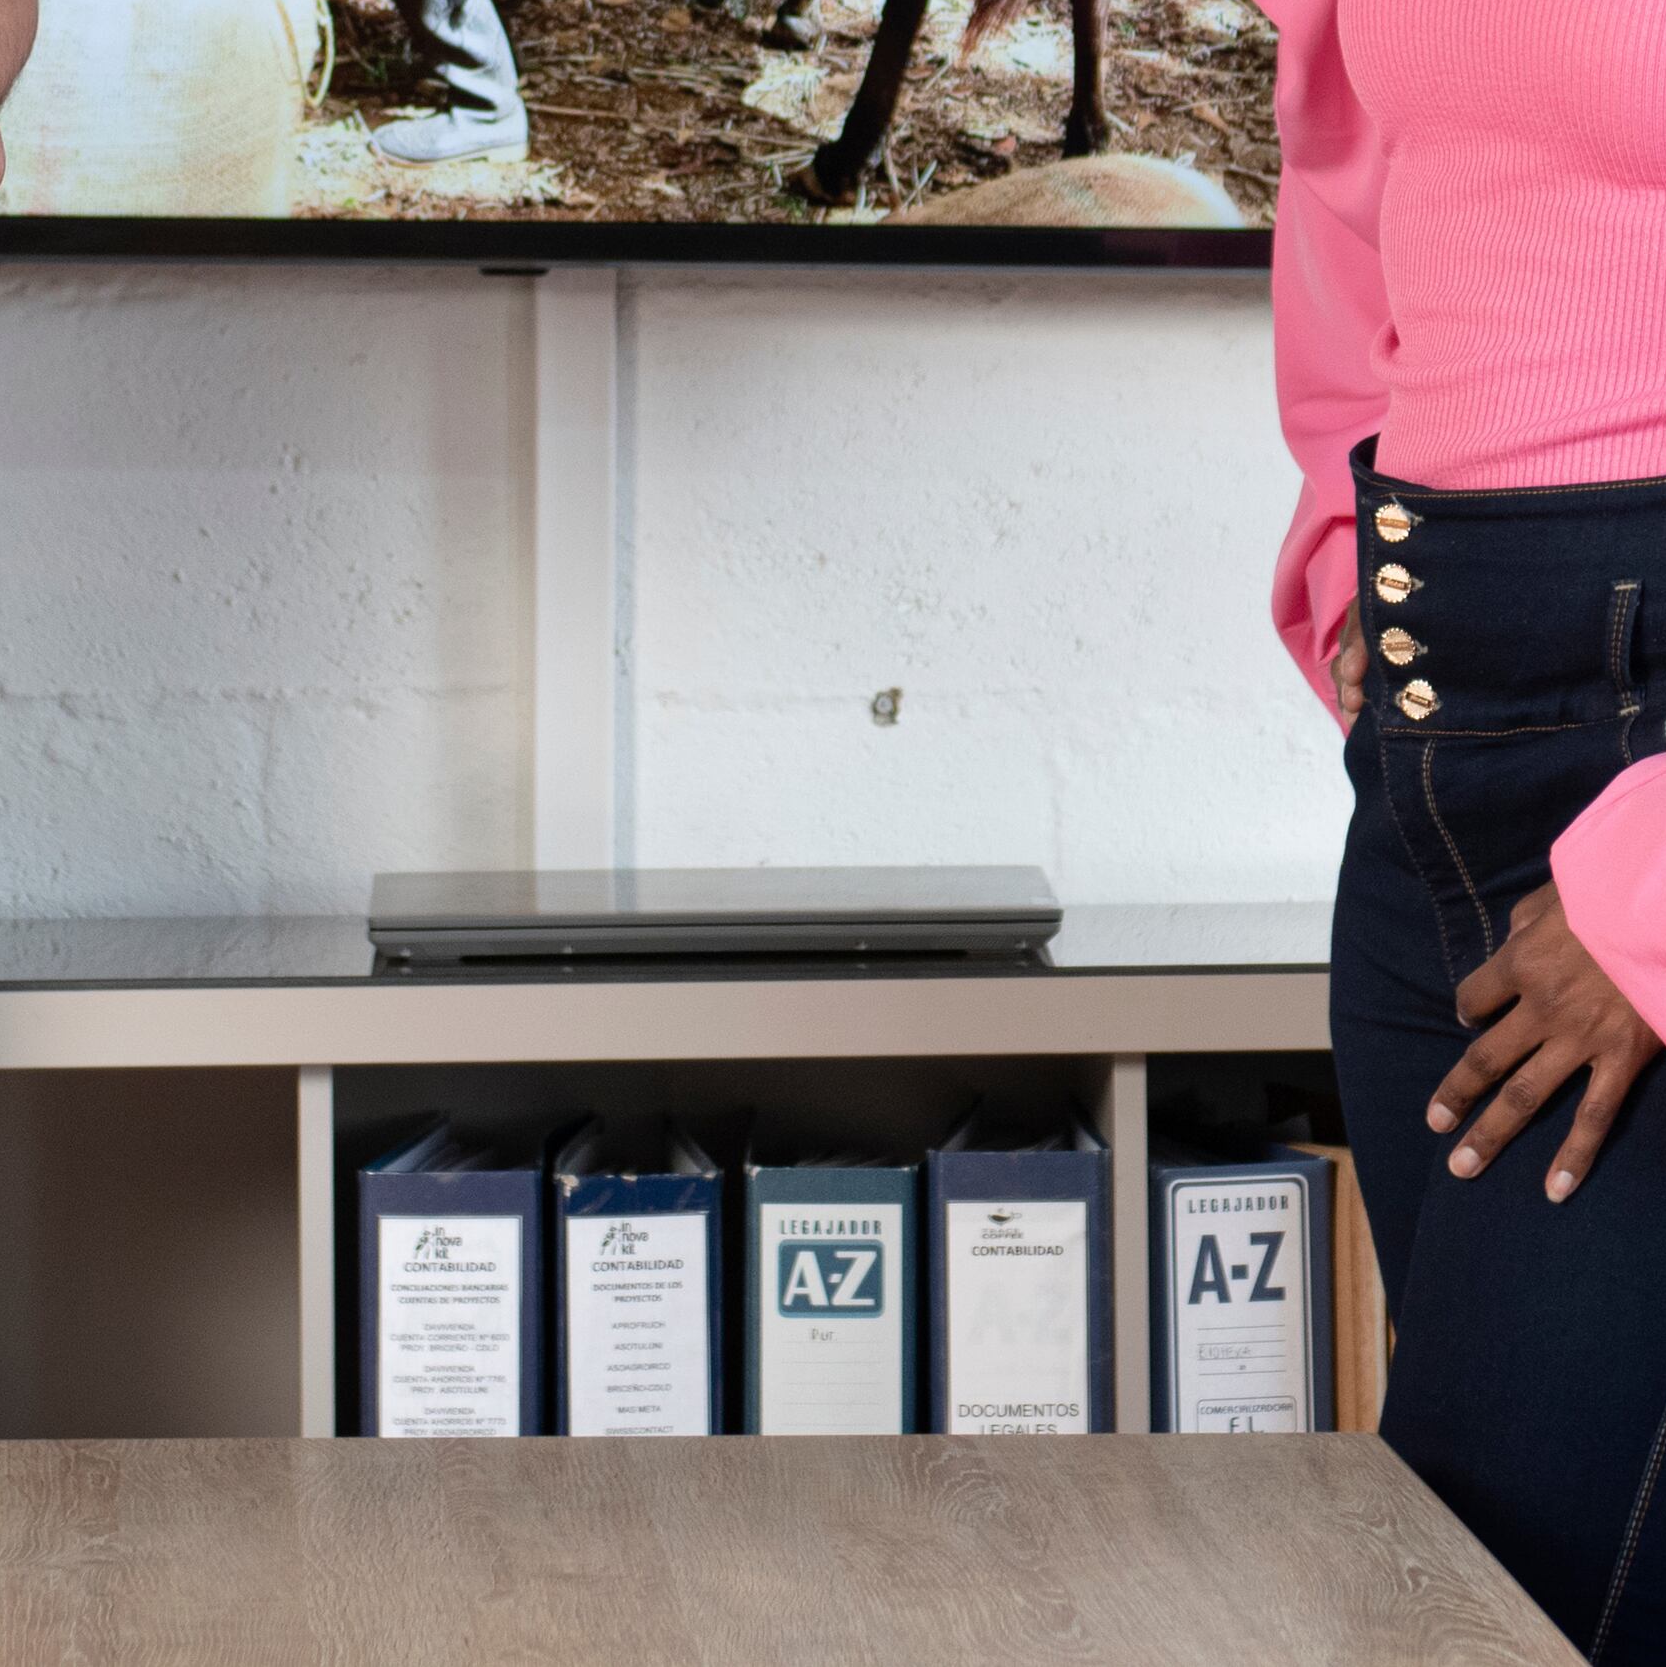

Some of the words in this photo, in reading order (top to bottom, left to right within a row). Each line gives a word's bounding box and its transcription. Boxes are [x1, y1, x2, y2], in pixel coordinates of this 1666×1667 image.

[1188, 1194, 1289, 1214] LEGAJADOR
[779, 1219, 883, 1235] LEGAJADOR
[972, 1245, 1064, 1256] CONTABILIDAD
[404, 1262, 497, 1273] CONTABILIDAD
[592, 1258, 684, 1272] CONTABILIDAD
[1188, 1230, 1286, 1305] A-Z
[783, 1250, 878, 1306] A-Z
[958, 1403, 1080, 1418] DOCUMENTOS
[1200, 1403, 1294, 1415] COMERCIALIZADORA
[981, 1424, 1058, 1434] LEGALES
